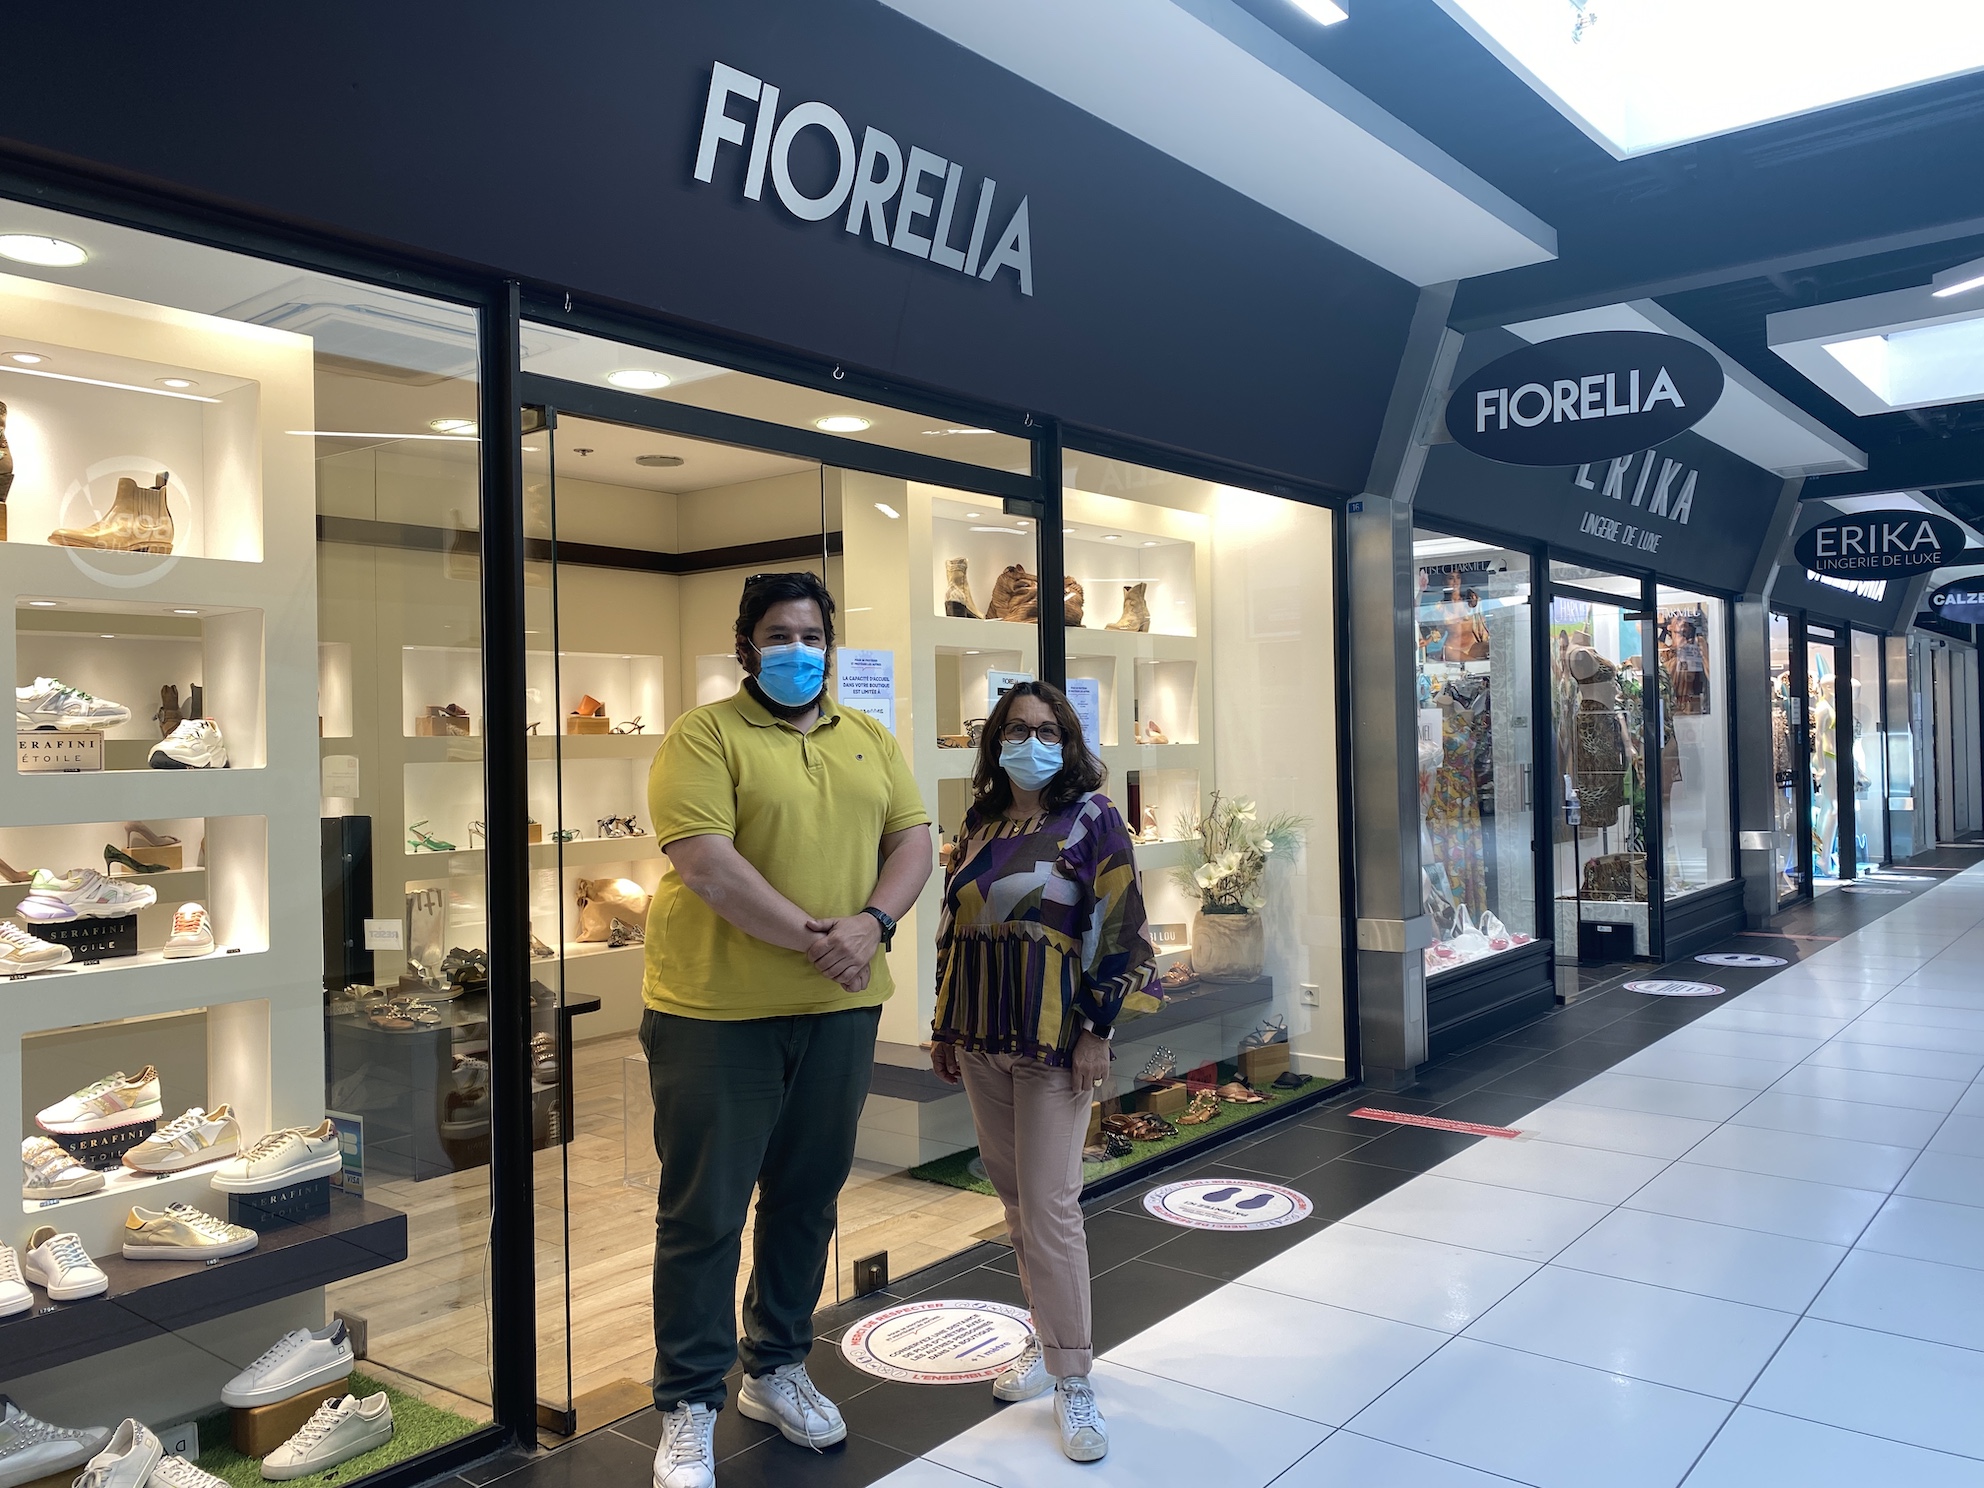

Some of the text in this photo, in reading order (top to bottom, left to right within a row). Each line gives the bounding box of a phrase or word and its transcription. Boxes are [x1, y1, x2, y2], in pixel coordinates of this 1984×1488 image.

[693, 59, 1034, 297] FIORELIA
[1475, 365, 1686, 433] FIORELIA
[1580, 511, 1662, 553] LINGERIE DE LUXE
[1816, 520, 1941, 557] ERIKA
[1816, 552, 1941, 570] LINGERIE DE LUXE
[19, 740, 95, 749] ERAFINI
[22, 753, 81, 763] ÉTOILE
[50, 924, 125, 940] SERAFINI
[1159, 932, 1176, 941] LOU
[71, 941, 116, 953] TOILE
[70, 1129, 145, 1152] SERAFINI
[80, 1150, 123, 1165] ÉTOIL
[347, 1175, 360, 1185] VISA
[251, 1184, 319, 1207] SERAFINI
[261, 1202, 310, 1222] ÉTOILE
[851, 1303, 944, 1346] MERCI DE RESPECTER
[888, 1312, 980, 1357] CONSERVEZ UNE DISTANCE
[902, 1350, 914, 1358] DE
[913, 1342, 932, 1353] PLUS
[940, 1325, 967, 1340] MÈTRE
[965, 1317, 985, 1328] AVEC
[910, 1319, 994, 1361] LES AUTRES PERSONNES
[927, 1325, 995, 1360] DANS LA BOUTIQUE
[982, 1339, 1012, 1356] mètre
[913, 1370, 993, 1381] L'ENSEMBLE
